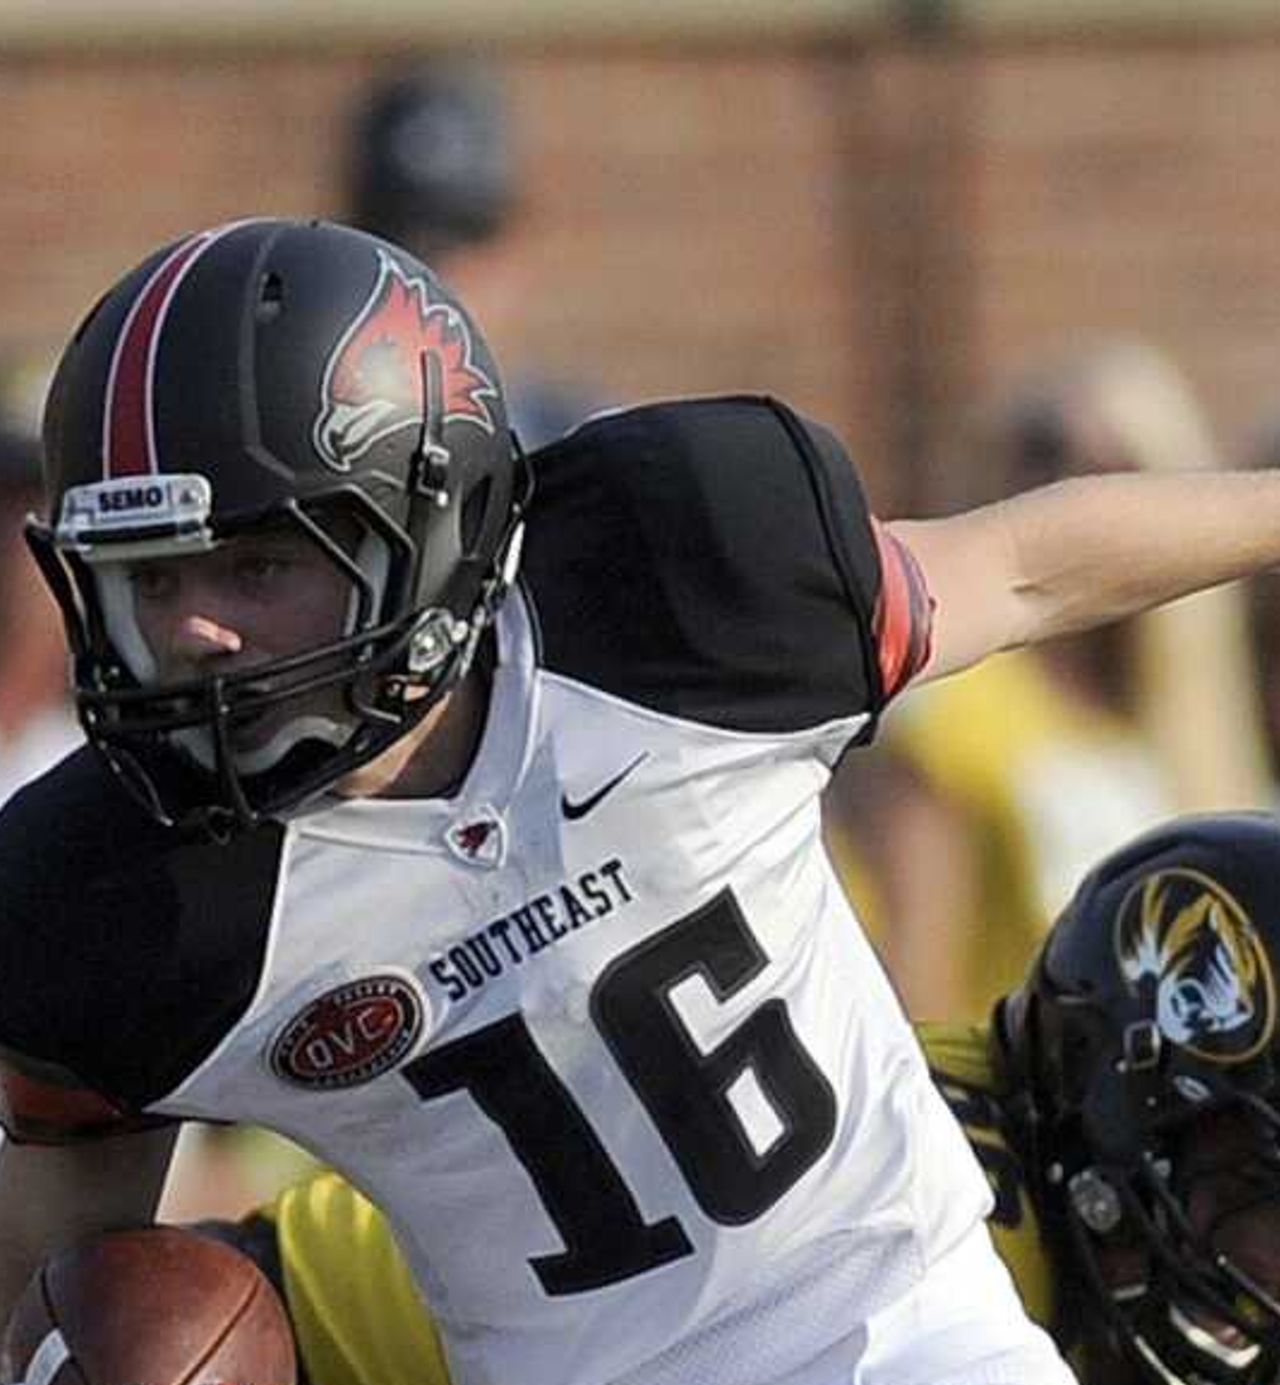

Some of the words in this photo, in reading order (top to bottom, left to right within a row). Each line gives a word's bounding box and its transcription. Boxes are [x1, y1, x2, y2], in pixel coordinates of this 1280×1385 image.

[99, 485, 163, 512] SEMO
[429, 860, 634, 1002] SOUTHEAST
[306, 1004, 390, 1072] OVC
[399, 883, 838, 1297] 16
